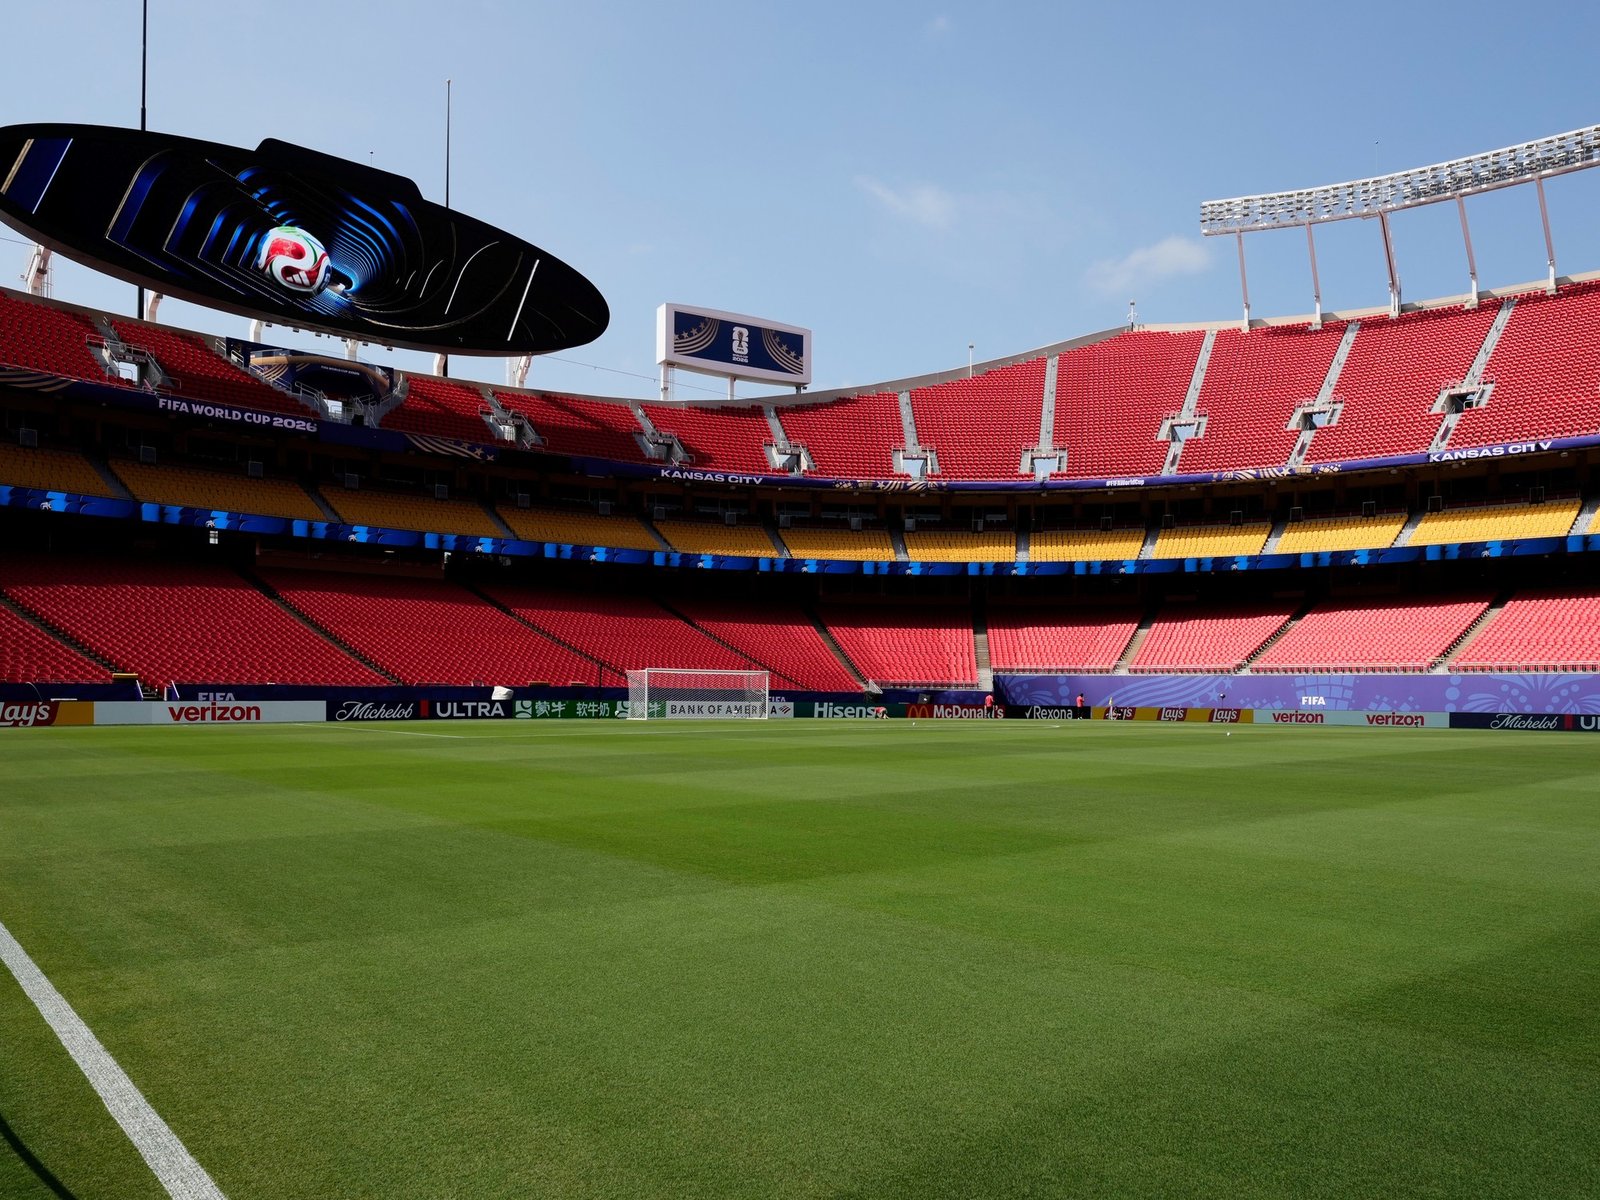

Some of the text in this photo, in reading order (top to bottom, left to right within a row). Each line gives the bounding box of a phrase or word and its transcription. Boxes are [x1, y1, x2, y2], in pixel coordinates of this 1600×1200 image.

[158, 398, 318, 433] FIFA WORLD CUP 2026
[1429, 441, 1553, 463] KANSAS CITY
[660, 469, 763, 485] KANSAS CITY
[1301, 696, 1326, 706] FIFA
[168, 702, 261, 721] verizon
[335, 700, 505, 721] Michelob ULTRA
[535, 701, 610, 718] 蒙牛 软牛奶
[670, 704, 777, 715] BANK OF AMERA
[814, 702, 877, 718] Hisens
[1033, 705, 1073, 719] Rexona
[1160, 706, 1184, 721] Lay's
[1212, 708, 1237, 723] Lay's
[1272, 710, 1324, 723] verizon
[1366, 712, 1425, 726] verizon
[1490, 713, 1558, 730] Michelob
